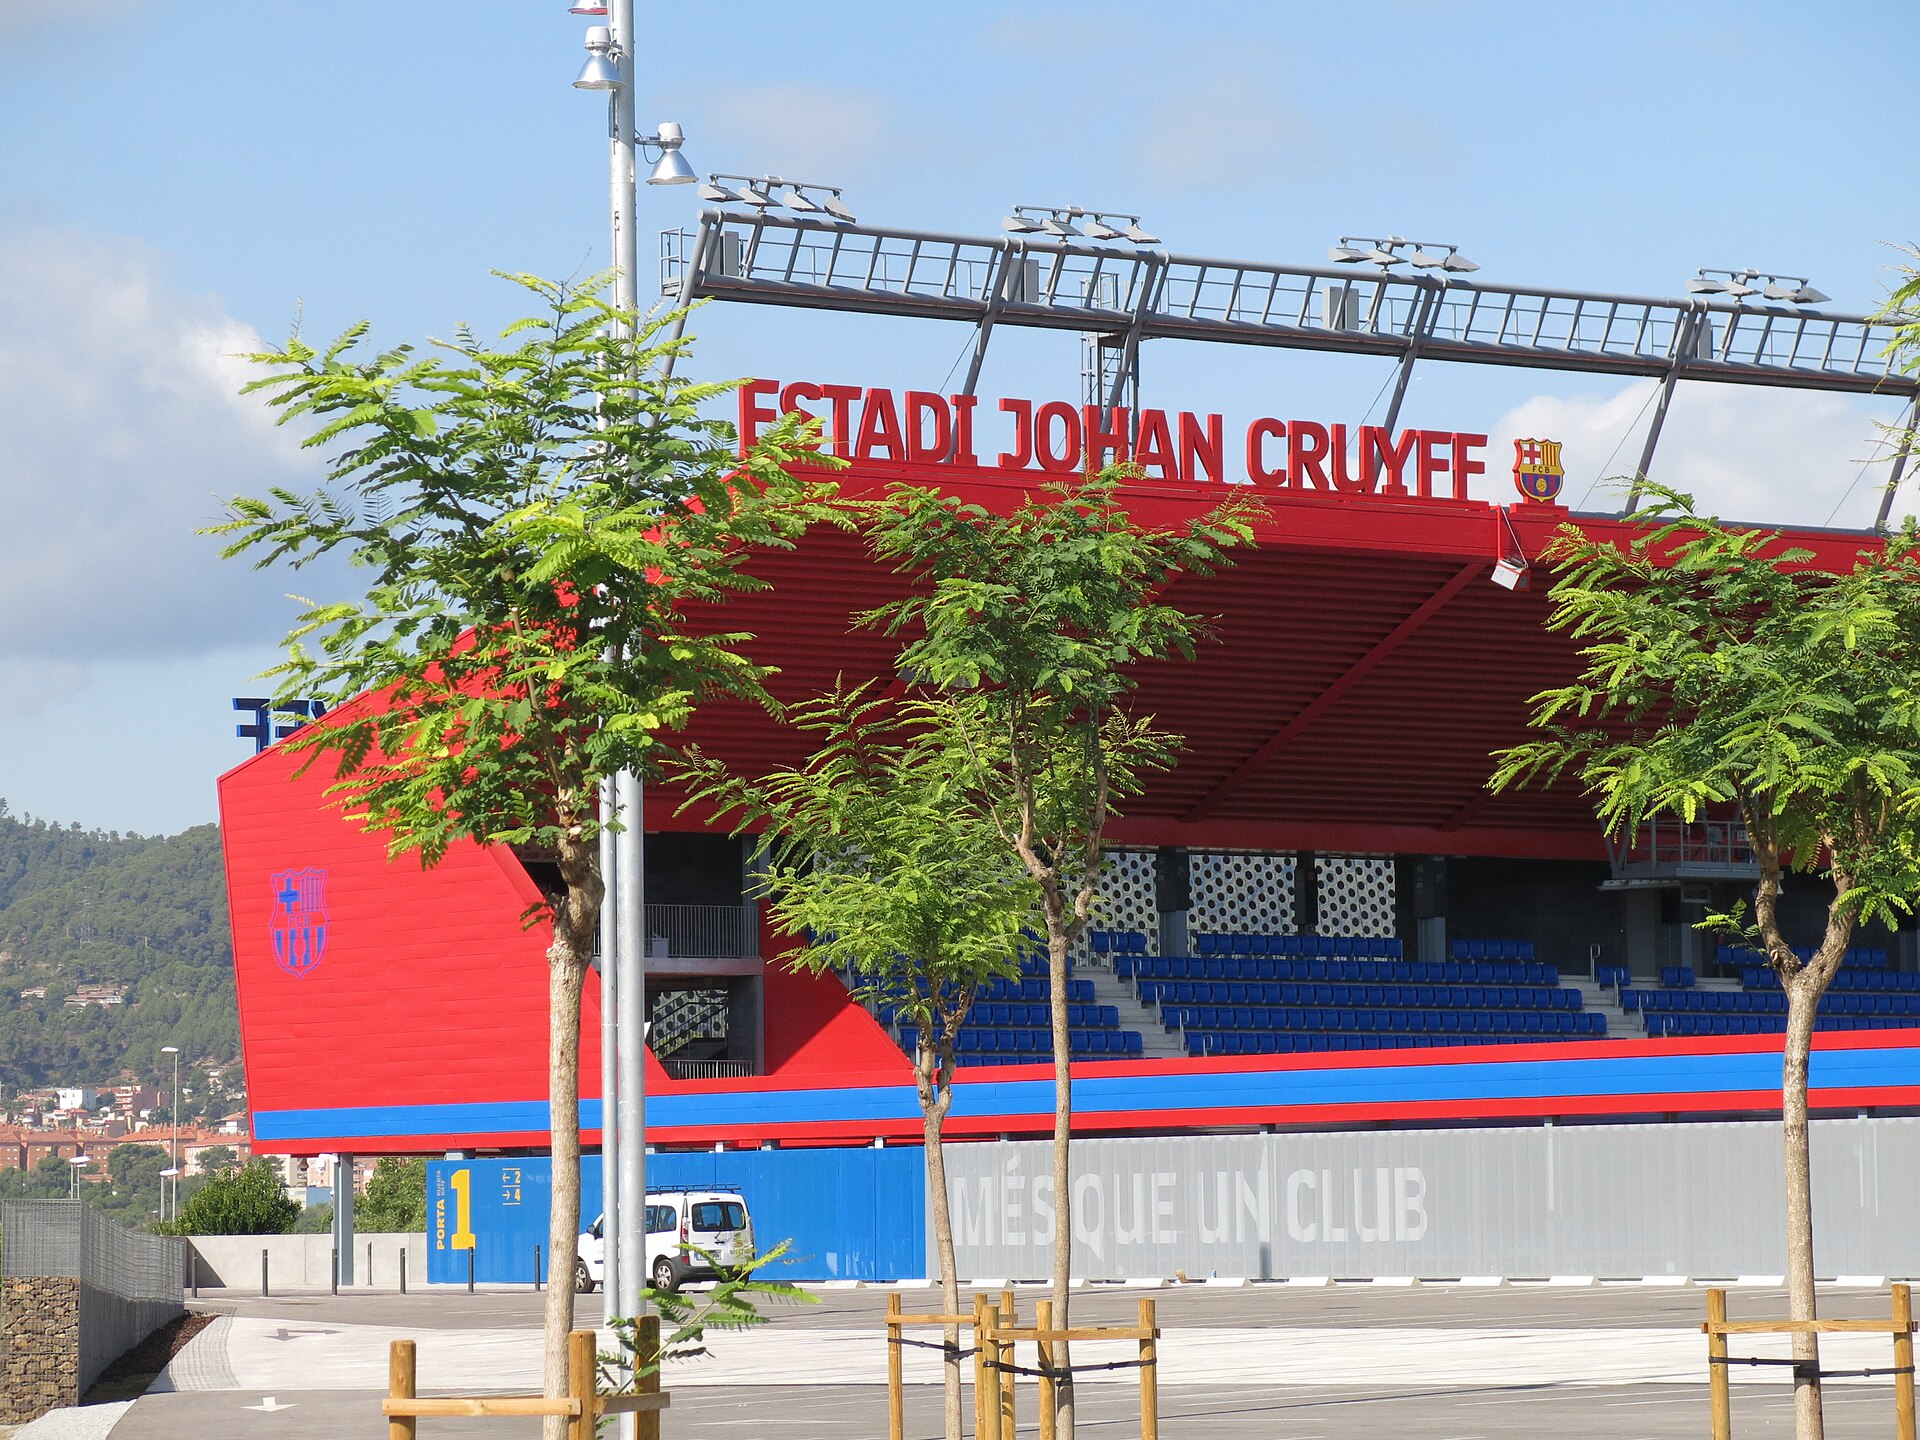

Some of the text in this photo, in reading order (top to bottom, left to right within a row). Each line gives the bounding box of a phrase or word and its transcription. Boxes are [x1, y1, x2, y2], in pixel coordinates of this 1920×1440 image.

[738, 378, 1488, 499] ESTADI JOHAN CRUYFF
[1532, 465, 1550, 474] FCB
[289, 914, 310, 927] FCB
[514, 1171, 521, 1184] 2
[451, 1169, 476, 1250] 1
[514, 1188, 521, 1202] 4
[953, 1152, 1428, 1261] MÉS QUE UN CLUB
[437, 1199, 445, 1250] PORTA
